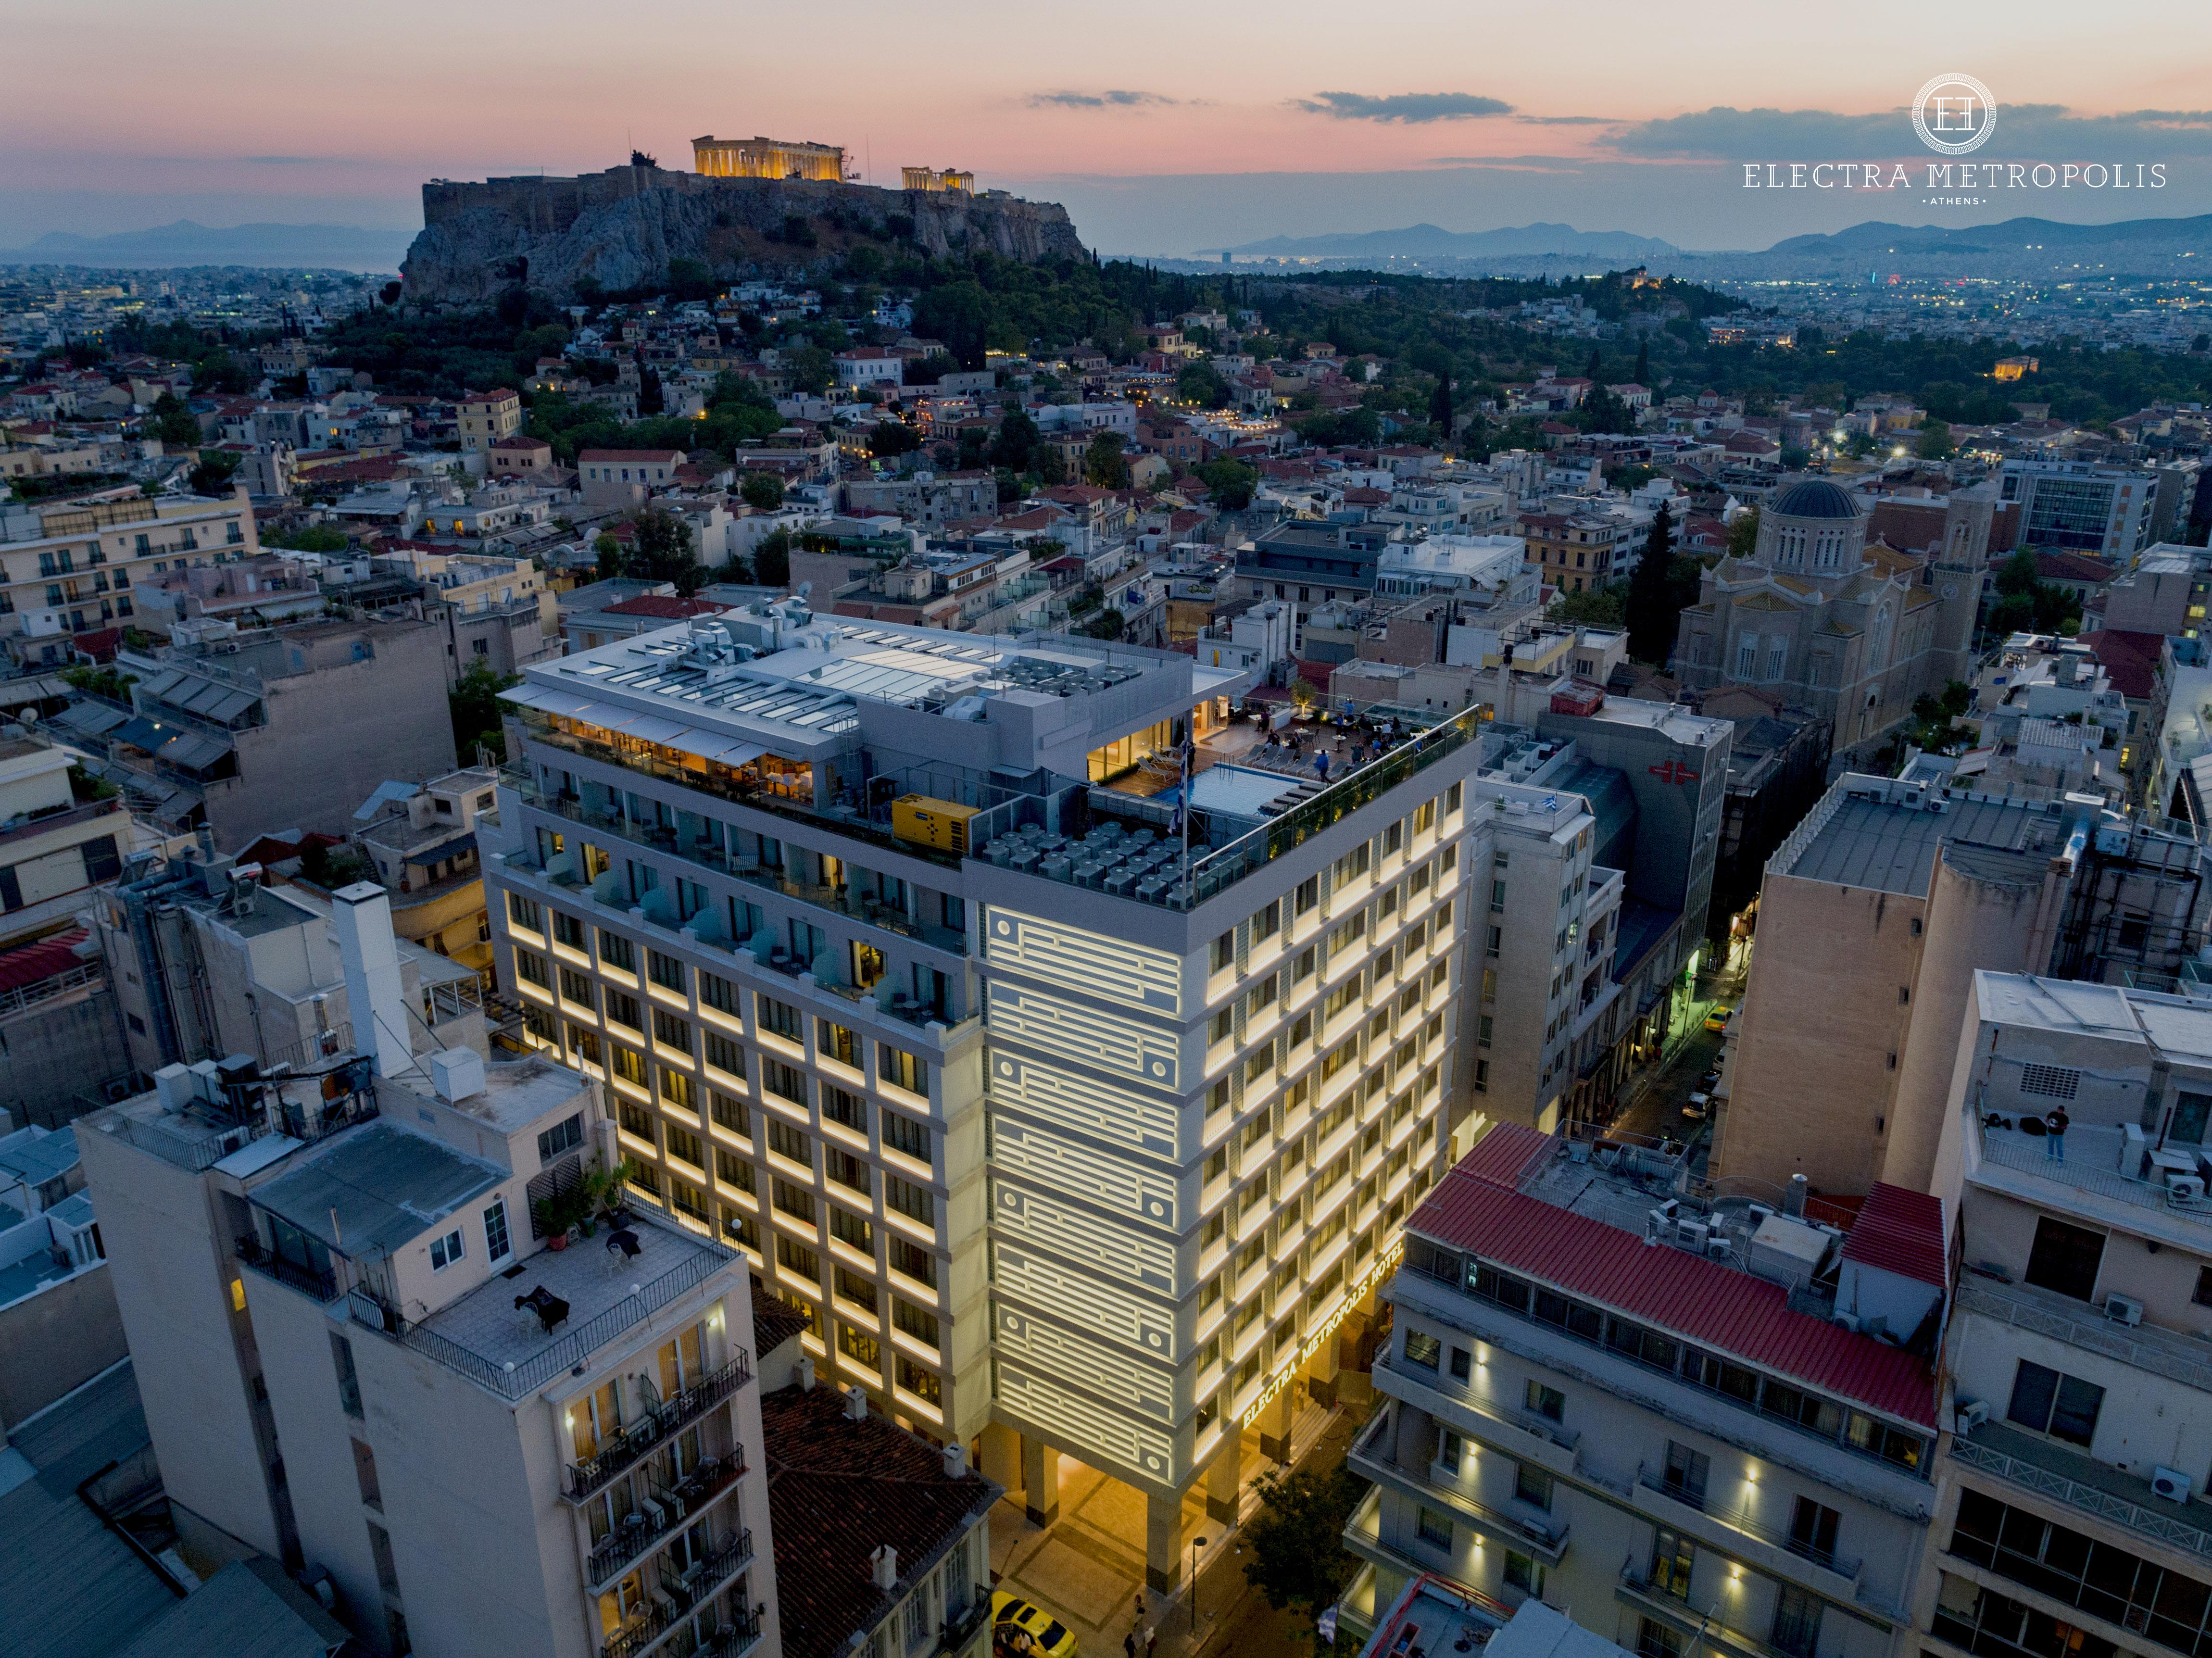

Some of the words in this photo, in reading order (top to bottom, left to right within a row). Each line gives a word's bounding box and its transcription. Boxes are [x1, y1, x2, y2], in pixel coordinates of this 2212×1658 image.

[1243, 1361, 1297, 1430] ELECTRA
[1302, 1280, 1367, 1364] METROPOLIS
[1371, 1242, 1403, 1285] HOTEL
